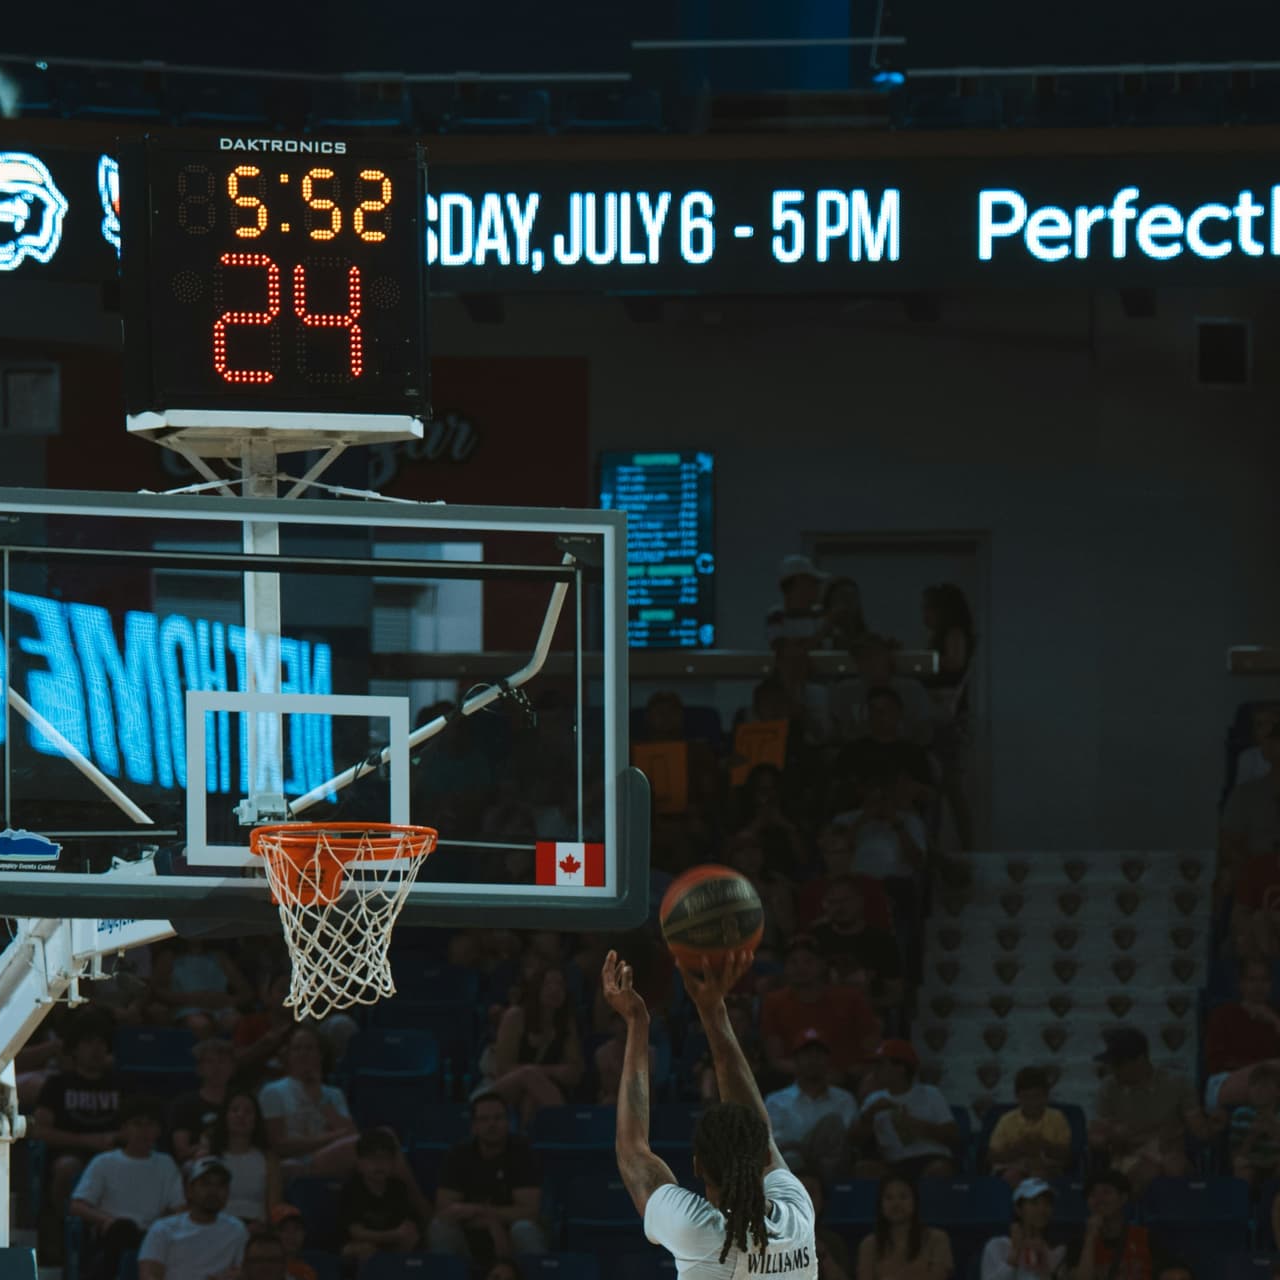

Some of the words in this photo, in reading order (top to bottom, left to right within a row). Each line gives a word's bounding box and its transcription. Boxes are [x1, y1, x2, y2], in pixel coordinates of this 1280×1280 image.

[220, 138, 347, 154] DAKTRONICS
[228, 165, 393, 242] 5:52
[552, 191, 671, 266] JULY
[679, 191, 715, 264] 6
[770, 190, 806, 263] 5
[818, 188, 900, 262] PM
[214, 253, 363, 383] 24
[747, 1247, 809, 1275] WILLIAMS
